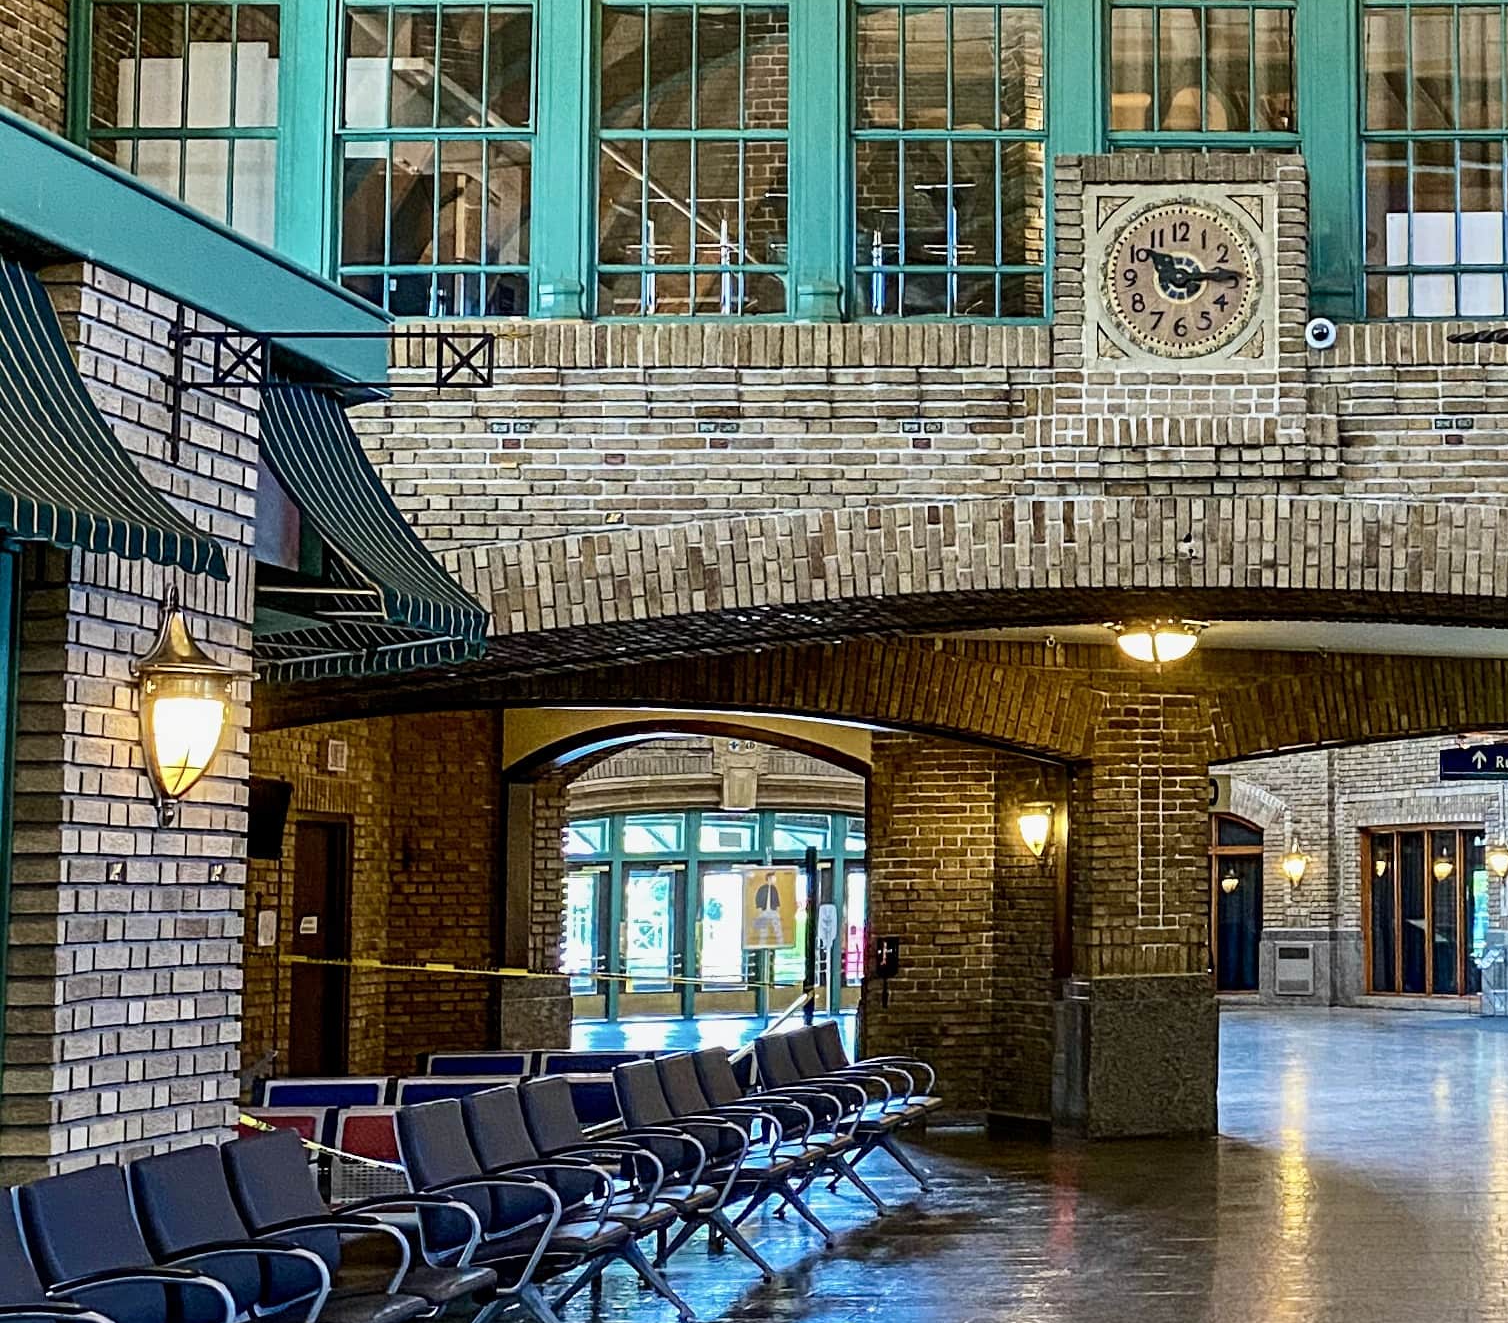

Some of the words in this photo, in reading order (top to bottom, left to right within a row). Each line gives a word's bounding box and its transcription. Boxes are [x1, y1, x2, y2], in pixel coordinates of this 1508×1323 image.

[1150, 228, 1164, 248] 11
[1172, 221, 1190, 242] 12
[1201, 229, 1207, 249] 1
[1130, 244, 1150, 263] 10
[1216, 243, 1229, 263] 2
[1123, 269, 1138, 287] 9
[1132, 293, 1145, 313] 8
[1213, 293, 1229, 312] 4
[1150, 311, 1165, 331] 7
[1173, 317, 1188, 337] 6
[1196, 311, 1213, 331] 5
